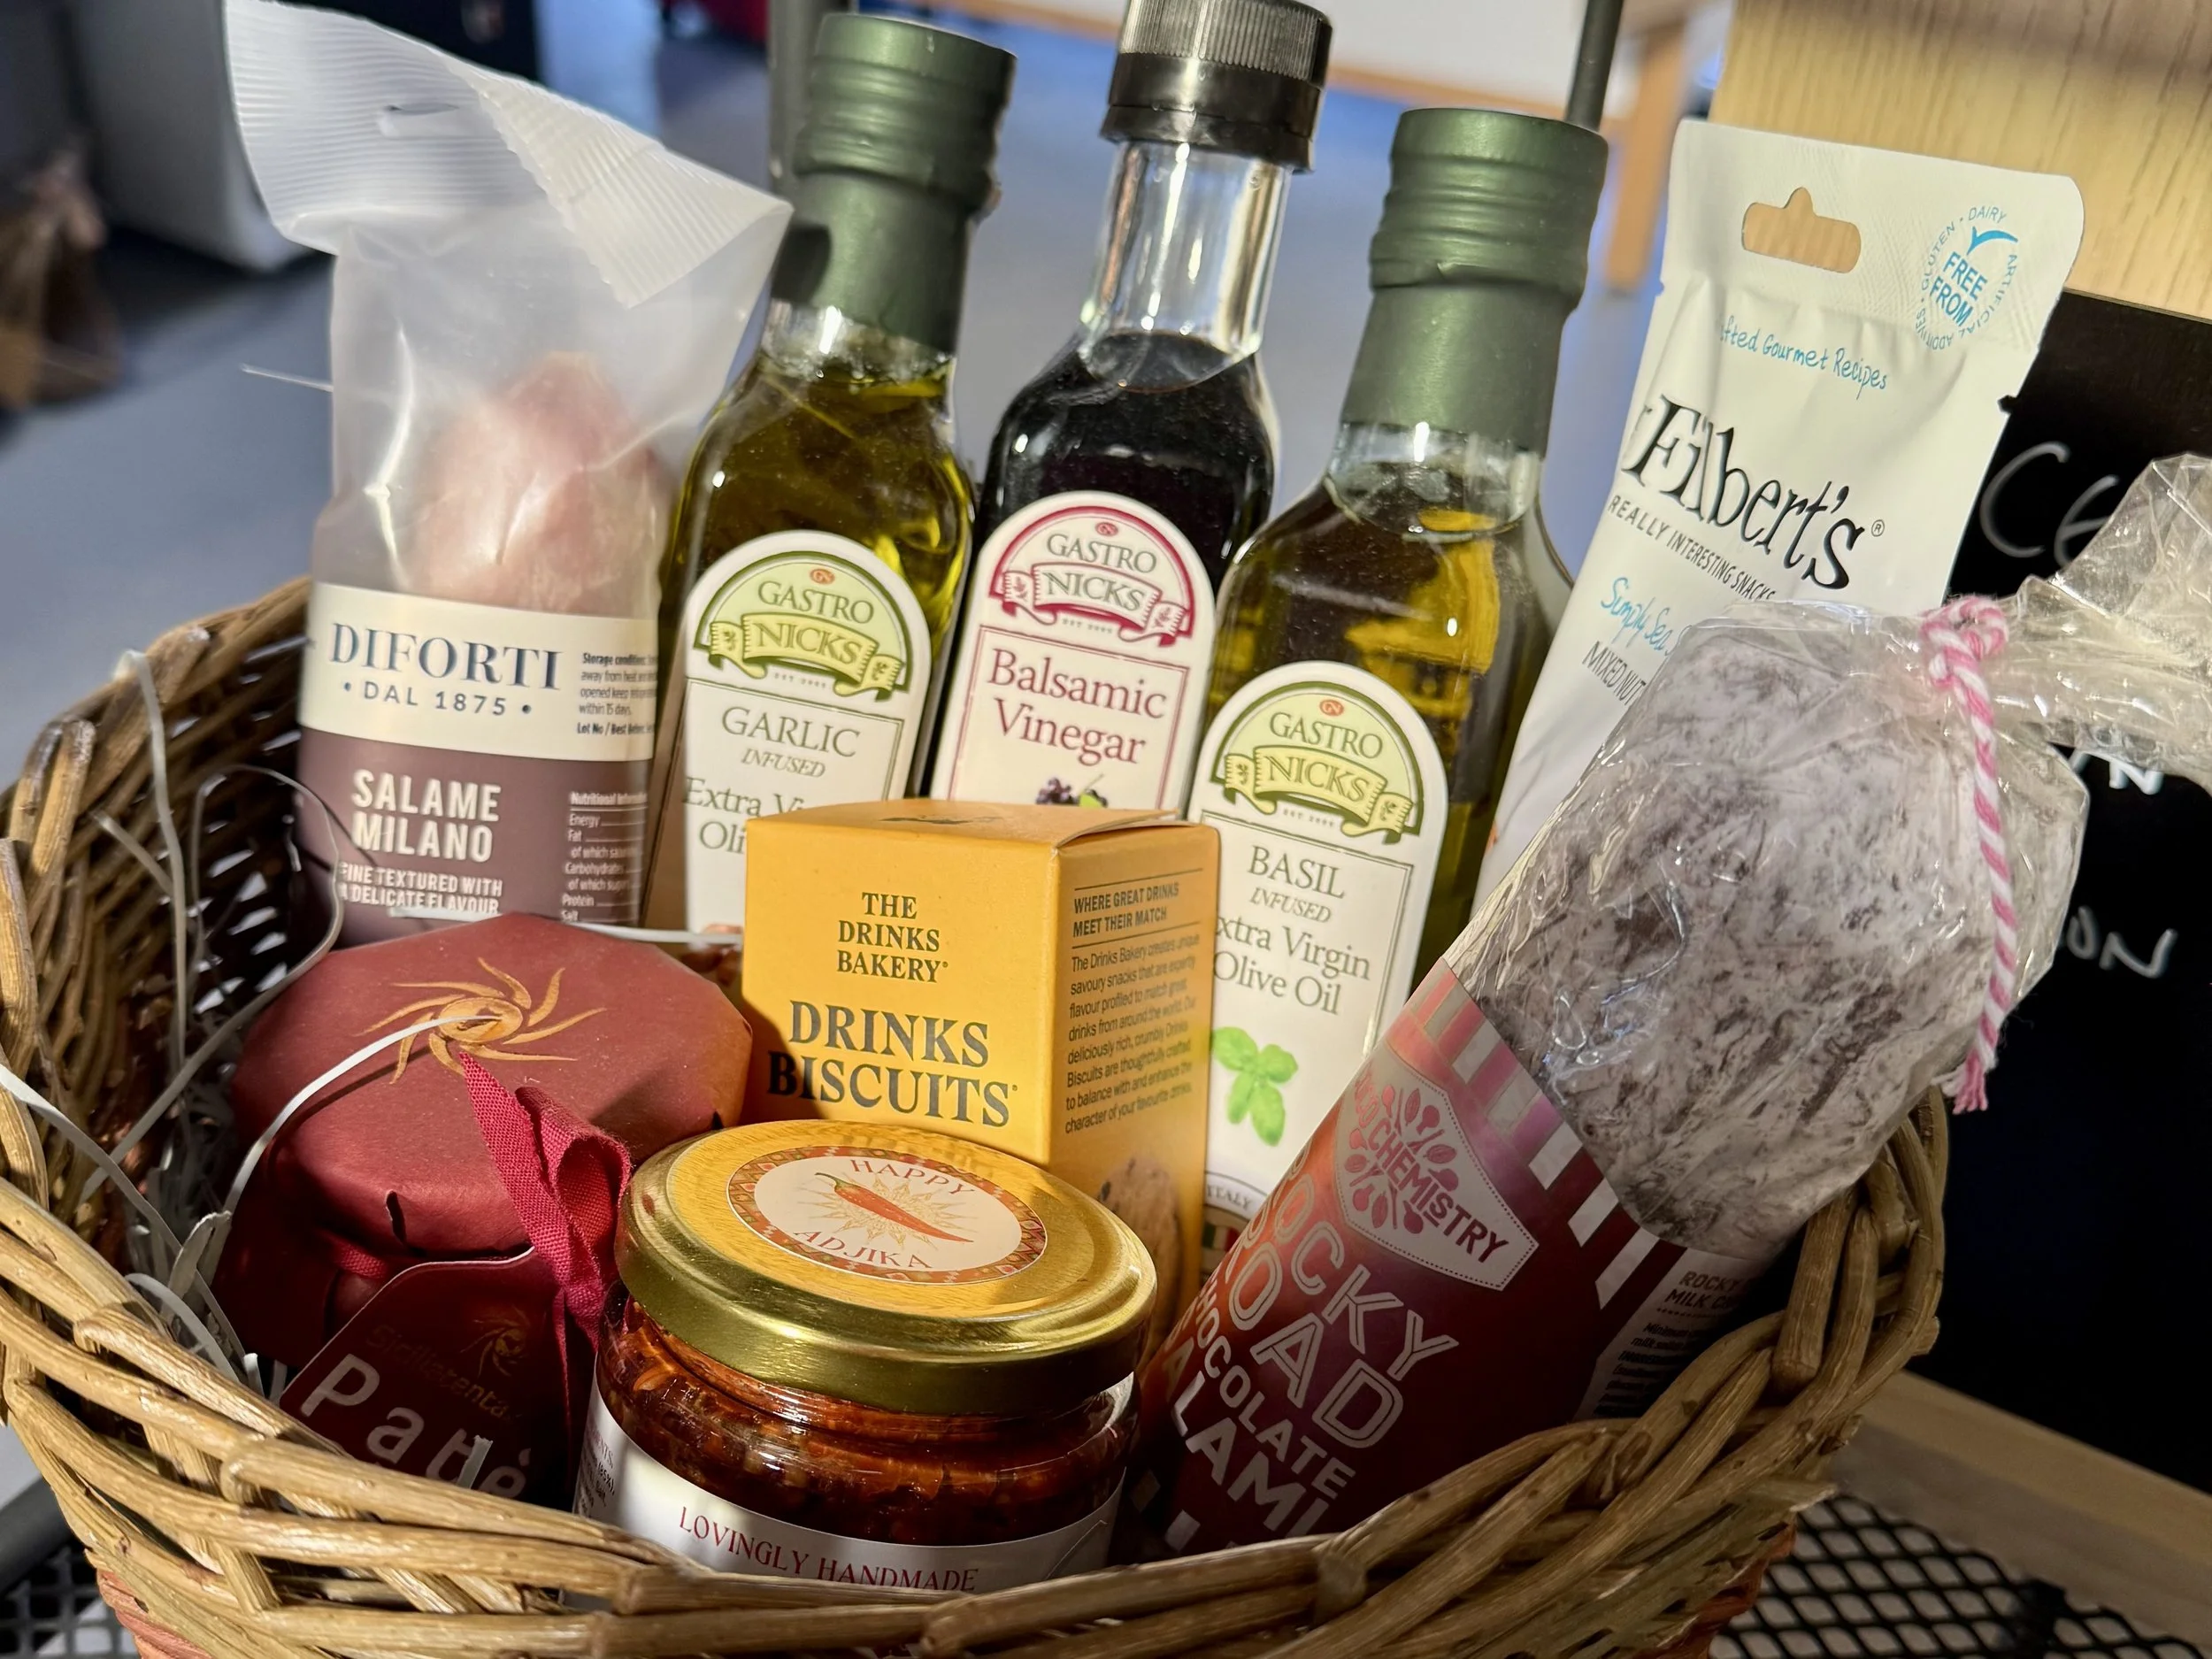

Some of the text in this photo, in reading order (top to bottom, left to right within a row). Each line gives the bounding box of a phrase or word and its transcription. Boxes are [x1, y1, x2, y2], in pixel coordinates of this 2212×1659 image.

[1968, 205, 2007, 223] DAIRY
[1943, 251, 1987, 301] FREE
[1930, 276, 1973, 326] FROM
[1763, 334, 1828, 370] Gourmet
[1832, 347, 1887, 400] Recipes
[1621, 395, 1865, 590] Filbert's
[1047, 533, 1157, 574] GASTRO
[1607, 493, 1671, 541] REALLY
[1666, 529, 1736, 587] INTERESTING
[758, 580, 874, 625] GASTRO
[1041, 572, 1146, 612] NICKS
[330, 622, 564, 690] DIFORTI
[754, 622, 864, 665] NICKS
[1582, 641, 1628, 687] MIXED
[364, 680, 507, 716] DAL 1875
[987, 648, 1168, 720] Balsamic
[721, 706, 861, 757] GARLIC
[994, 696, 1146, 767] Vinegar
[1270, 711, 1383, 759] GASTRO
[741, 747, 826, 779] INFUSED
[1265, 756, 1371, 803] NICKS
[351, 769, 502, 822] SALAME
[682, 775, 763, 818] Extra
[353, 811, 494, 863] MILANO
[699, 820, 746, 854] Oli
[375, 865, 458, 894] TEXTURED
[460, 875, 503, 897] WITH
[1248, 846, 1345, 899] BASIL
[351, 885, 424, 909] DELICATE
[861, 892, 918, 920] THE
[1073, 881, 1179, 914] WHERE GREAT DRINKS
[1249, 887, 1333, 924] INFUSED
[838, 919, 941, 953] DRINKS
[1072, 906, 1167, 938] MEET THEIR MATCH
[836, 949, 941, 983] BAKERY
[1071, 956, 1088, 972] The
[1090, 950, 1118, 969] Drinks
[1119, 946, 1148, 963] Bakery
[1216, 916, 1371, 981] xtra Virgin
[1070, 977, 1106, 995] savoury
[1107, 970, 1138, 988] snacks
[1213, 950, 1342, 1016] Olive Oil
[1069, 1000, 1101, 1019] flavour
[1069, 1023, 1097, 1041] drinks
[1098, 1018, 1118, 1034] from
[788, 999, 989, 1069] DRINKS
[1067, 1040, 1115, 1064] deliciously
[766, 1050, 1010, 1128] BISCUITS
[1067, 1066, 1103, 1087] Biscuits
[1105, 1061, 1118, 1078] are
[1065, 1097, 1076, 1110] to
[1077, 1087, 1113, 1108] balance
[1113, 1080, 1131, 1096] with
[1064, 1110, 1107, 1133] character
[849, 1158, 975, 1195] HAPPY
[1368, 1119, 1509, 1263] CHEMISTRY
[793, 1231, 933, 1269] ADJIKA
[1663, 1288, 1709, 1310] MILK
[680, 1506, 979, 1592] LOVINGLY HANDMADE
